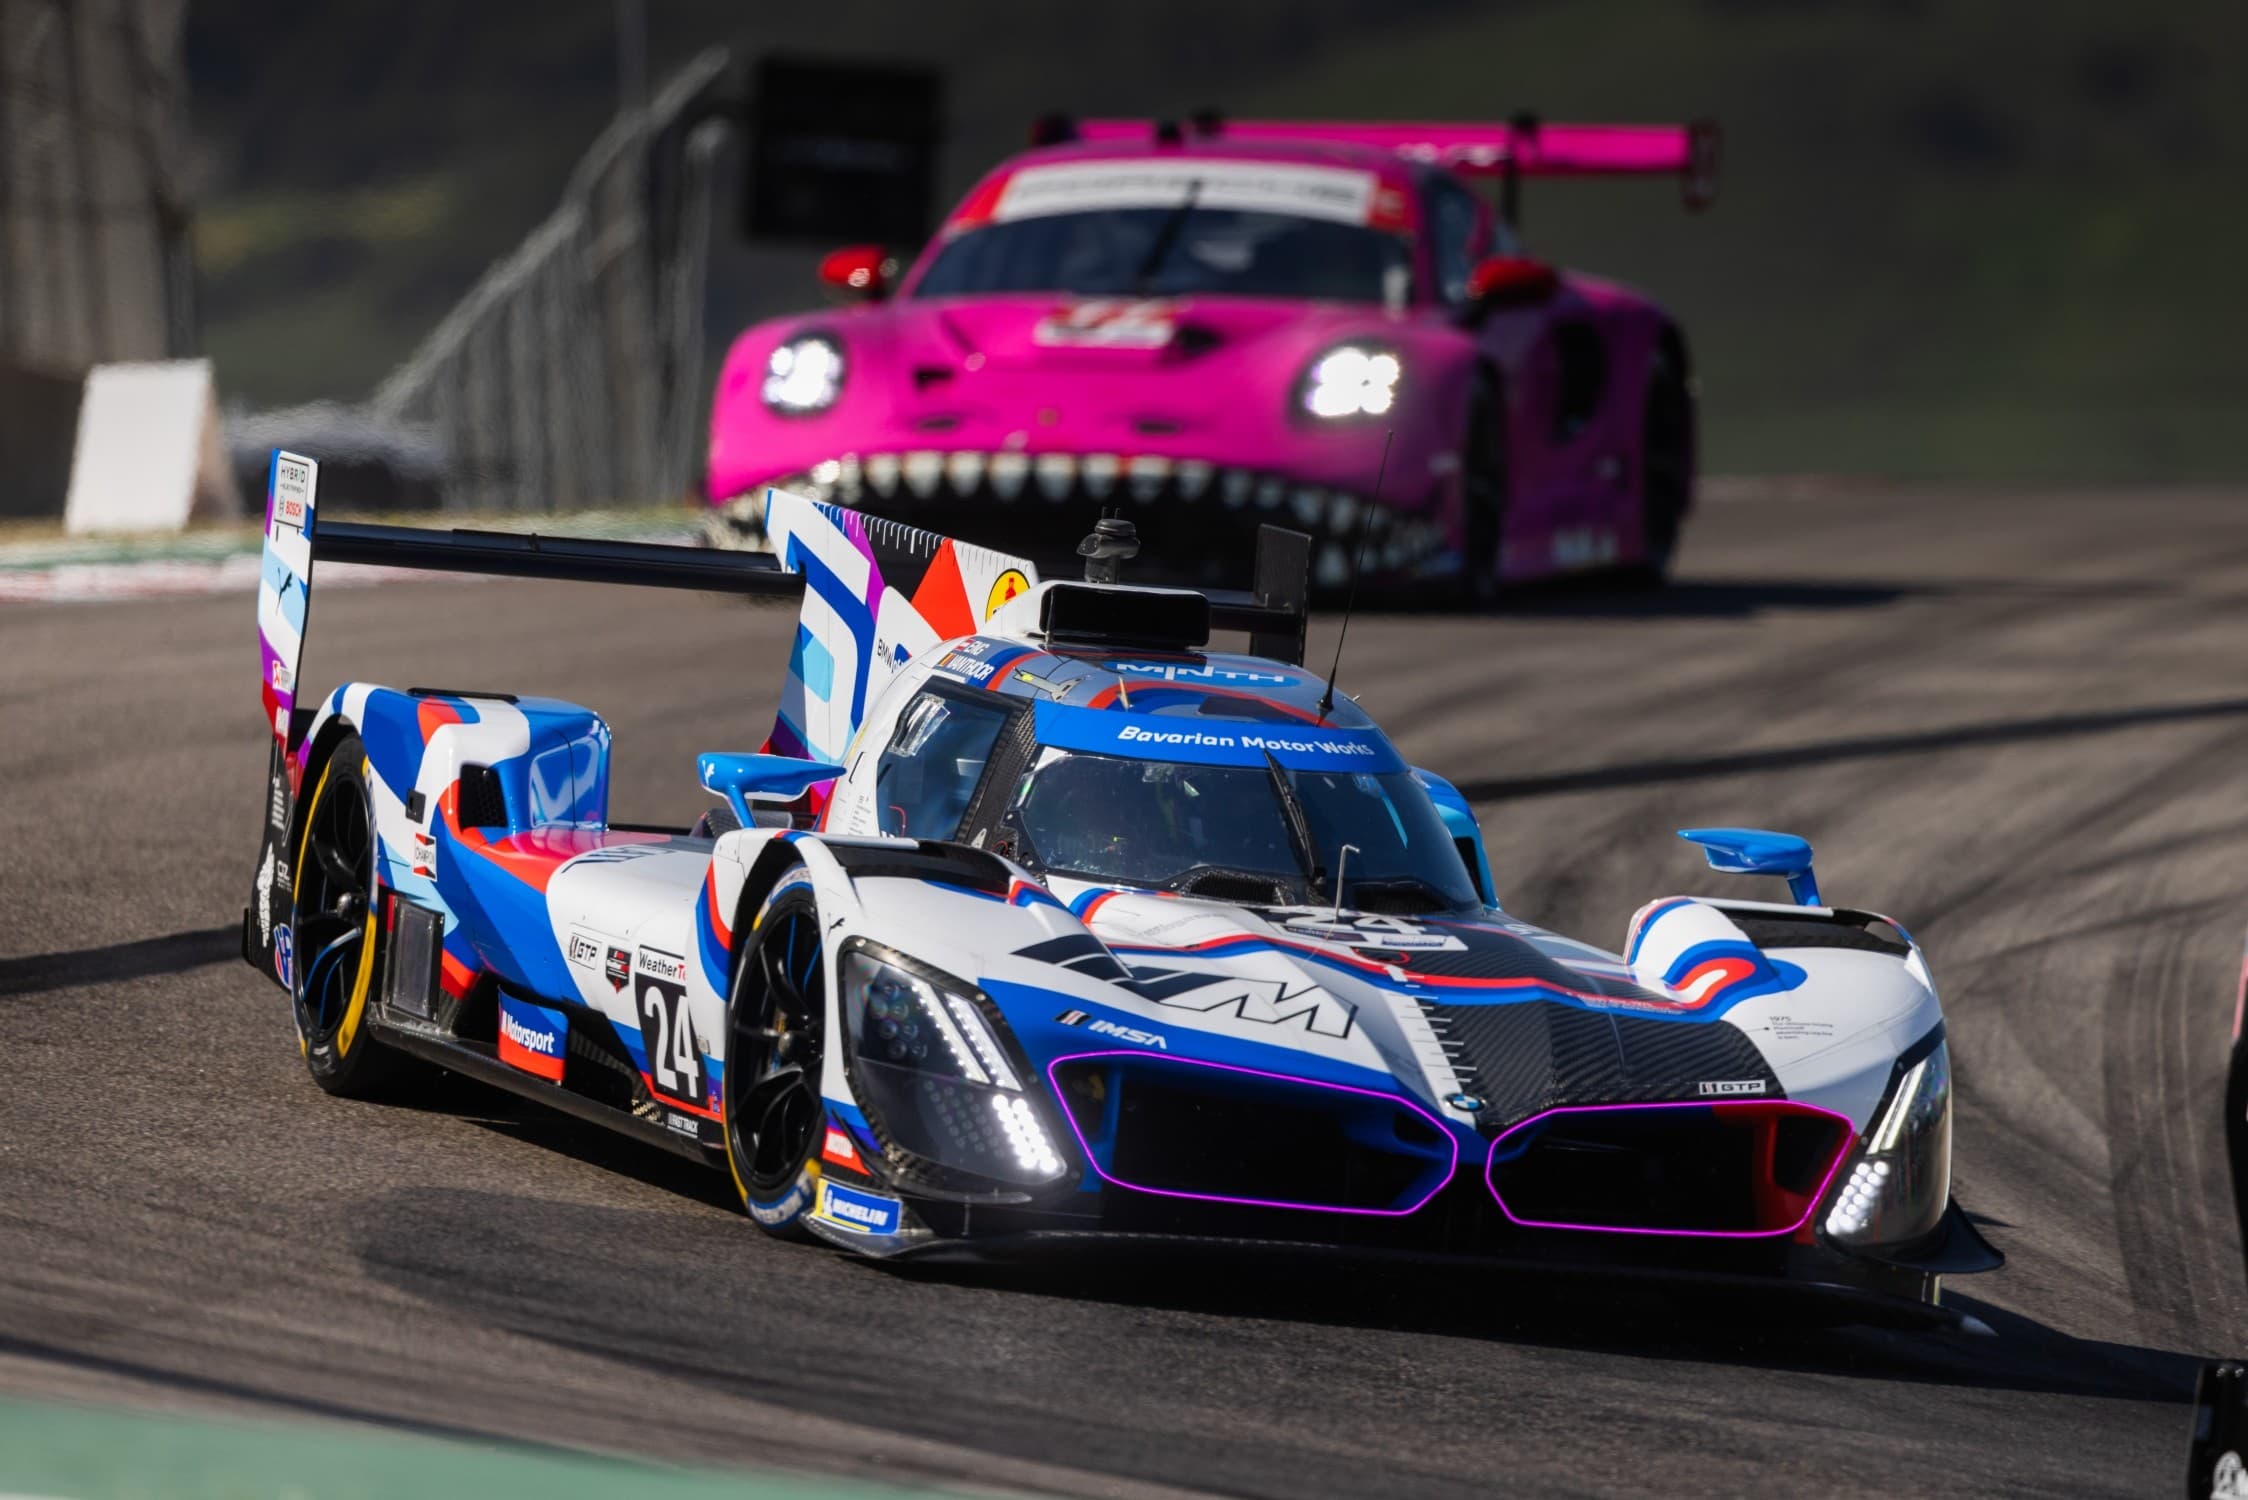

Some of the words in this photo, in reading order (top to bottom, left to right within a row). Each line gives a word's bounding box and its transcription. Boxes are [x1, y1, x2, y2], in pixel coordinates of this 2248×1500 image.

[280, 465, 305, 483] HYBRID
[286, 500, 302, 517] BOSCH
[877, 638, 893, 668] BMW
[1117, 725, 1235, 747] Bavarian
[576, 942, 598, 961] GTP
[644, 986, 699, 1098] 24
[1088, 1019, 1168, 1050] IMSA
[1721, 1082, 1761, 1092] GTP
[832, 1197, 889, 1227] MICHELIN
